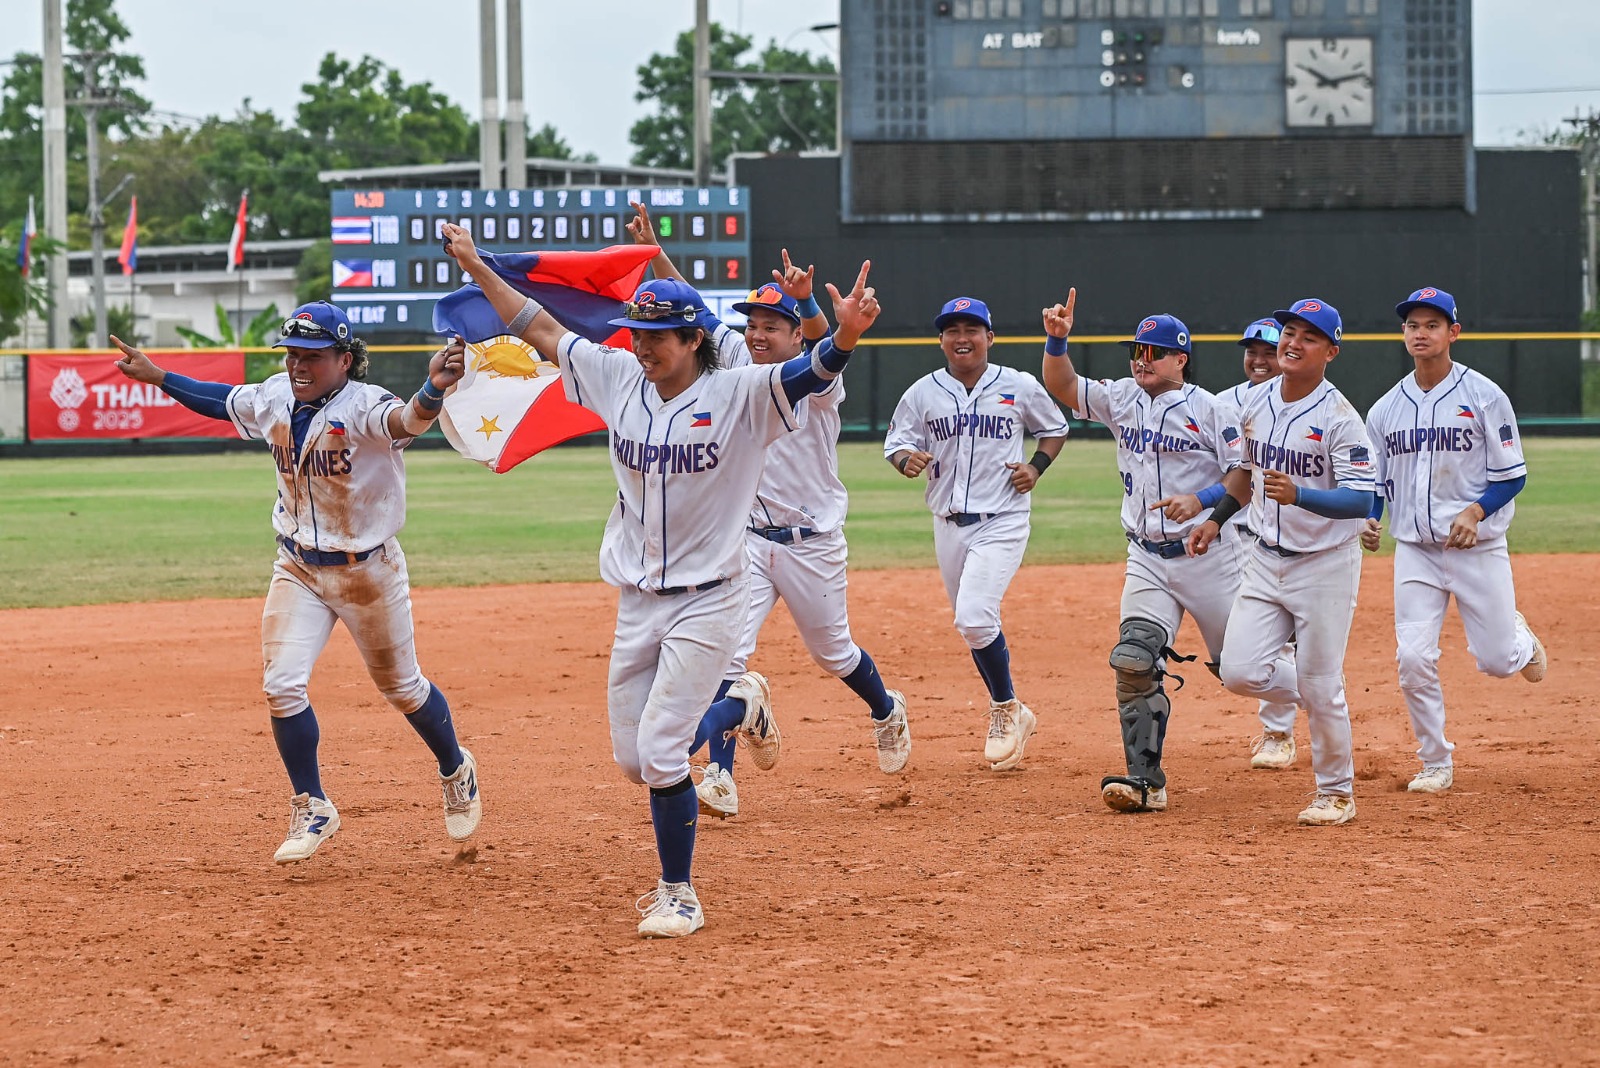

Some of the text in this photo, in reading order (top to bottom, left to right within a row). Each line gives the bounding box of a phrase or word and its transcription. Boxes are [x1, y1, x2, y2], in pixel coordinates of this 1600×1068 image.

[982, 31, 1044, 49] AT BAT
[1217, 28, 1260, 45] km/h
[415, 191, 422, 208] 1
[437, 190, 448, 208] 2
[461, 190, 472, 208] 3
[485, 190, 496, 208] 4
[509, 190, 520, 208] 5
[533, 190, 544, 208] 6
[557, 190, 568, 208] 7
[580, 189, 591, 207] 8
[650, 188, 684, 206] RUNS
[729, 187, 739, 206] E
[411, 218, 423, 239] 0
[483, 217, 496, 239] 0
[507, 217, 520, 239] 0
[531, 217, 544, 239] 2
[555, 216, 568, 239] 0
[581, 217, 590, 239] 1
[602, 217, 615, 239] 0
[660, 216, 672, 237] 3
[415, 262, 423, 283] 1
[436, 262, 449, 283] 0
[726, 259, 739, 279] 2
[91, 382, 178, 408] THAIL
[93, 409, 143, 430] 2025
[613, 429, 719, 474] PHILIPPINES
[1385, 427, 1473, 458] PHILIPPINES
